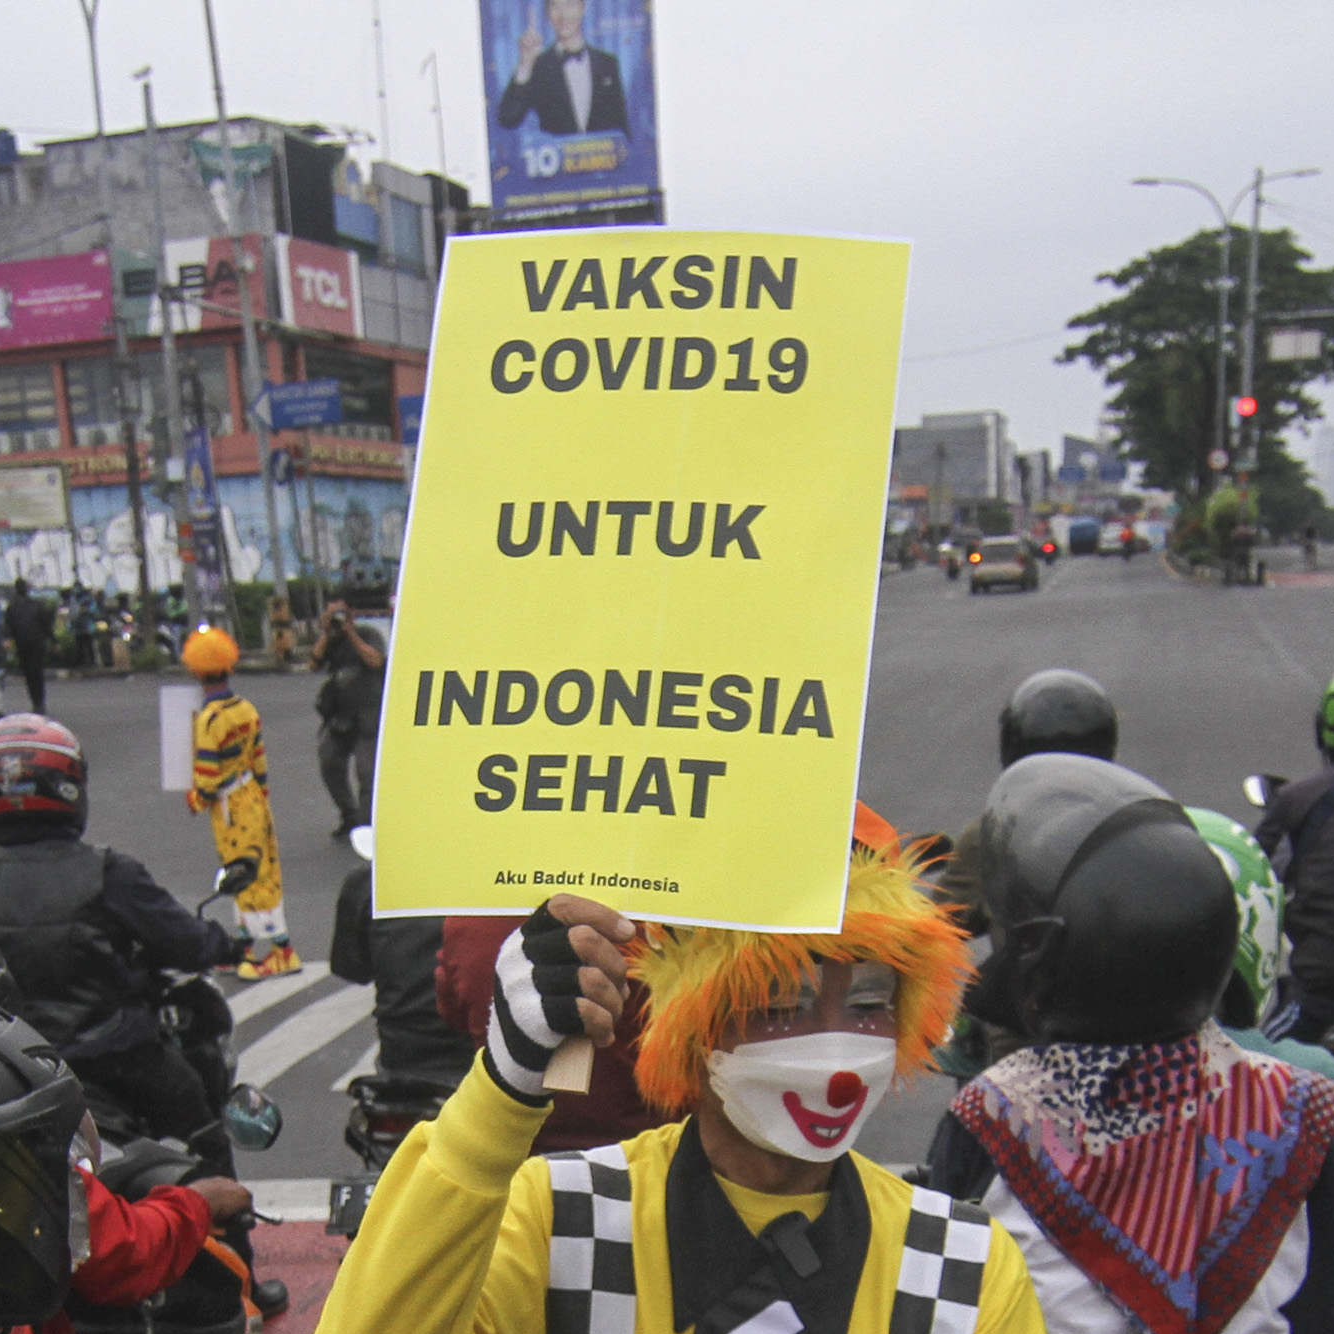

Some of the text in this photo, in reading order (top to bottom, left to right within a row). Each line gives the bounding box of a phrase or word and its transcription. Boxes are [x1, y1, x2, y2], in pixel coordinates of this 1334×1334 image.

[523, 146, 561, 178] 10
[296, 265, 348, 309] TCL
[521, 255, 798, 312] VAKSIN
[490, 337, 810, 395] COVID19
[496, 500, 765, 560] UNTUK
[413, 670, 835, 739] INDONESIA
[474, 754, 727, 820] SEHAT
[494, 870, 680, 893] Aku Badut Indonesia
